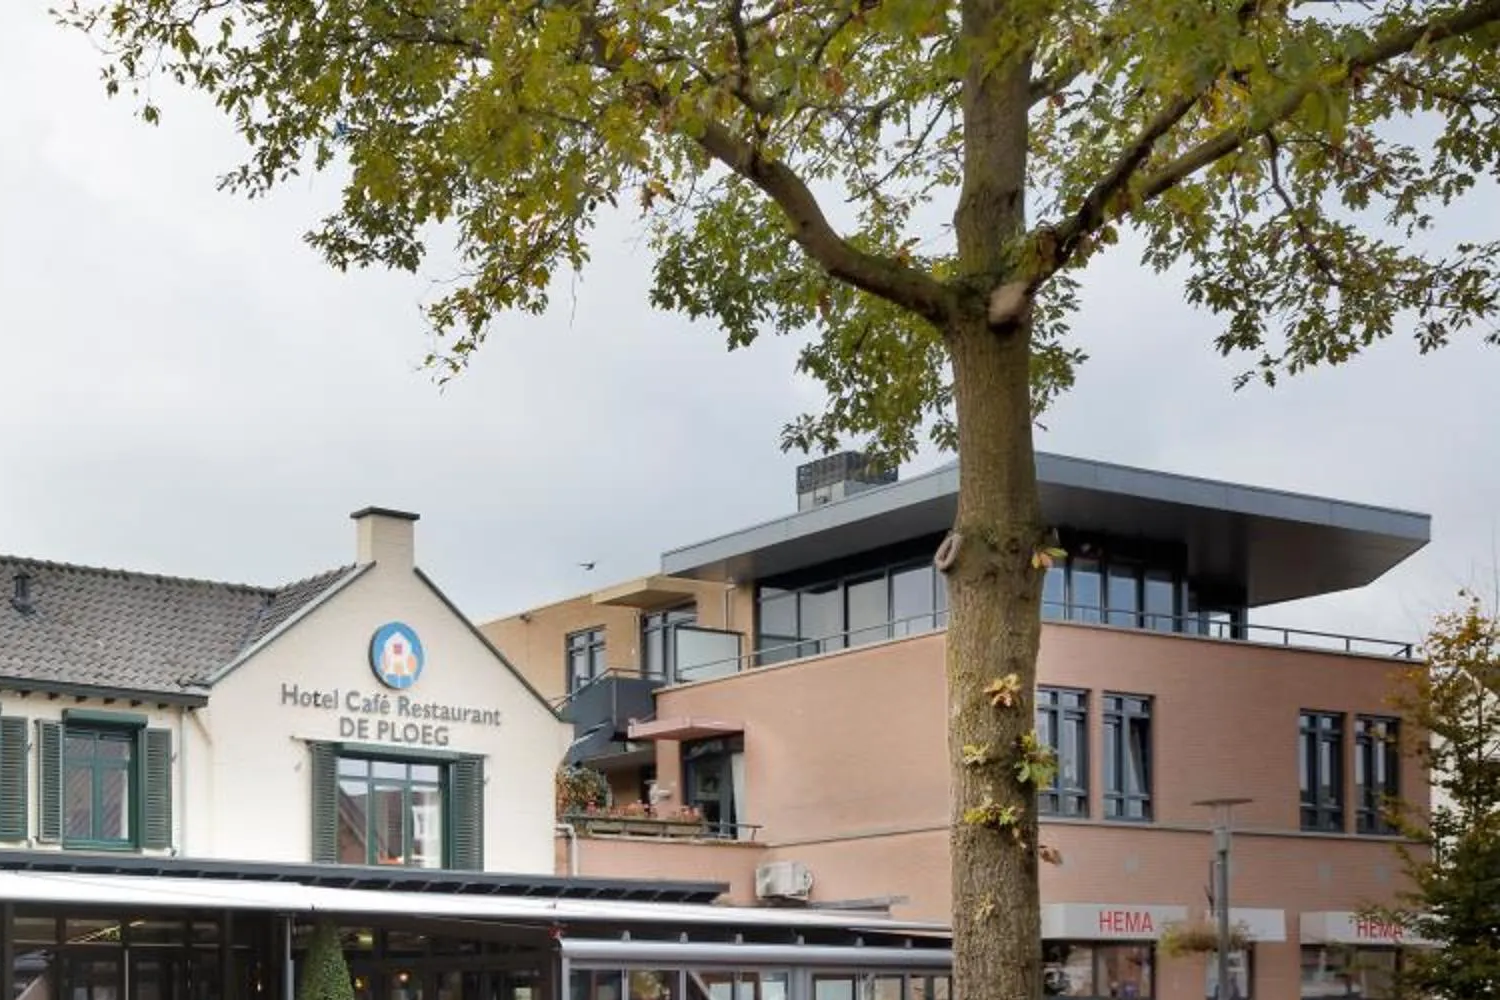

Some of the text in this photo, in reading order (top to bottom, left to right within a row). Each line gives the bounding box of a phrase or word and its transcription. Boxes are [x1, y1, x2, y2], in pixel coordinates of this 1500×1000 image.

[281, 683, 501, 727] Hotel Café Restaurant
[339, 716, 449, 747] DE PLOEG
[1099, 911, 1153, 933] HEMA
